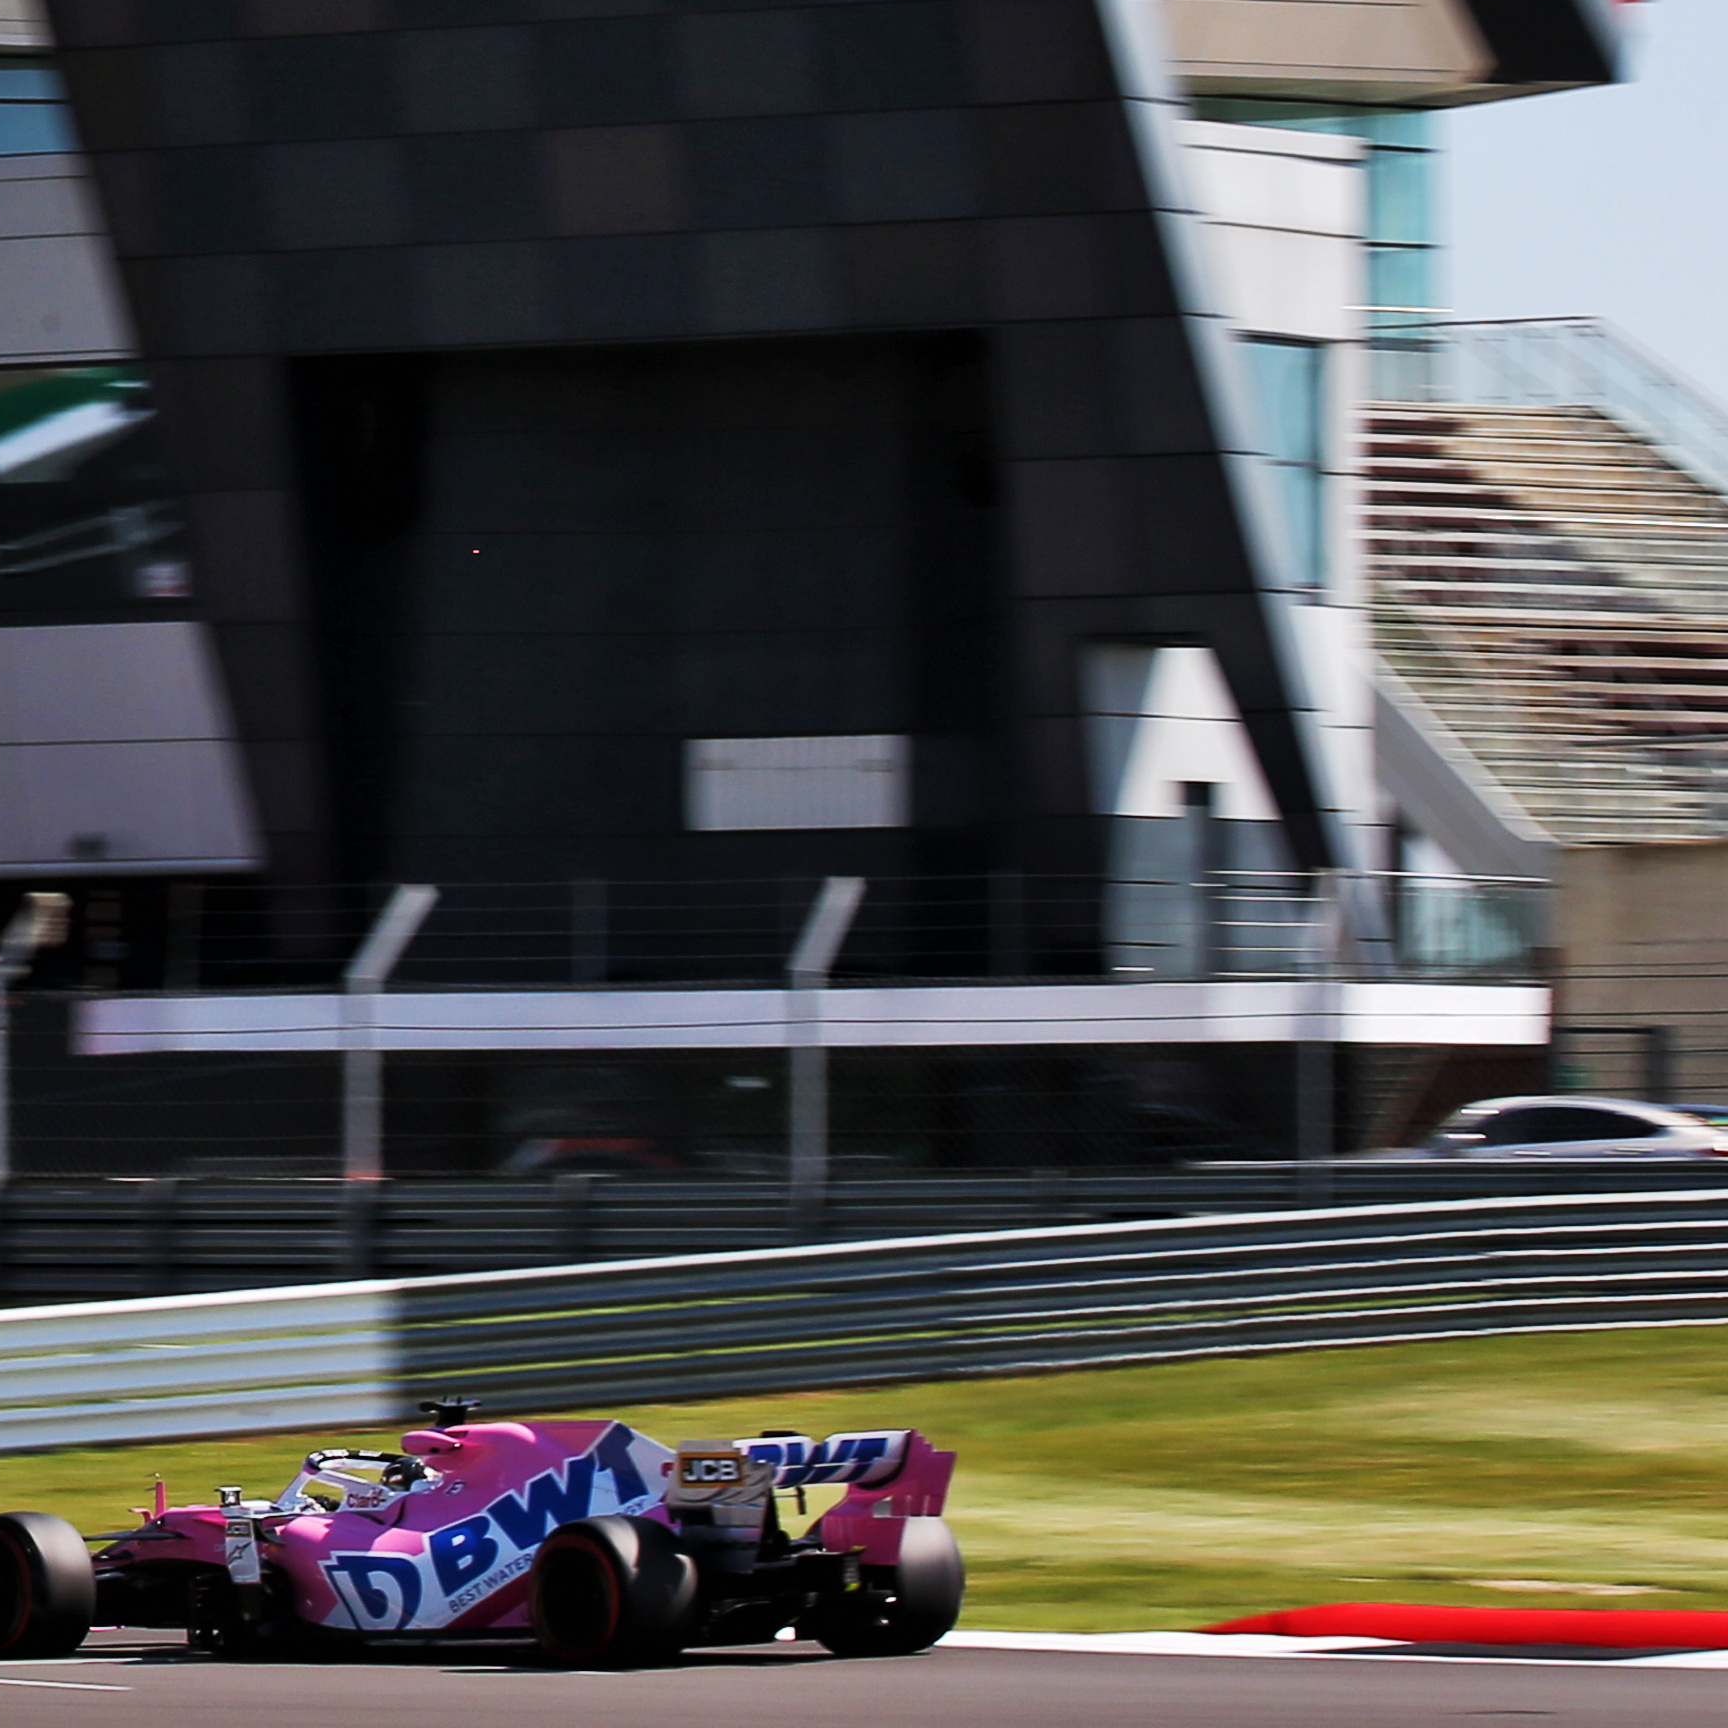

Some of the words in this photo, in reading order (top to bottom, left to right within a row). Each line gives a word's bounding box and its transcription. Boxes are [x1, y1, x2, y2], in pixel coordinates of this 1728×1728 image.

[684, 1460, 738, 1480] JCB
[347, 1489, 386, 1507] Claro
[430, 1422, 649, 1597] BWT
[449, 1585, 483, 1613] BEST
[484, 1553, 533, 1589] WATER
